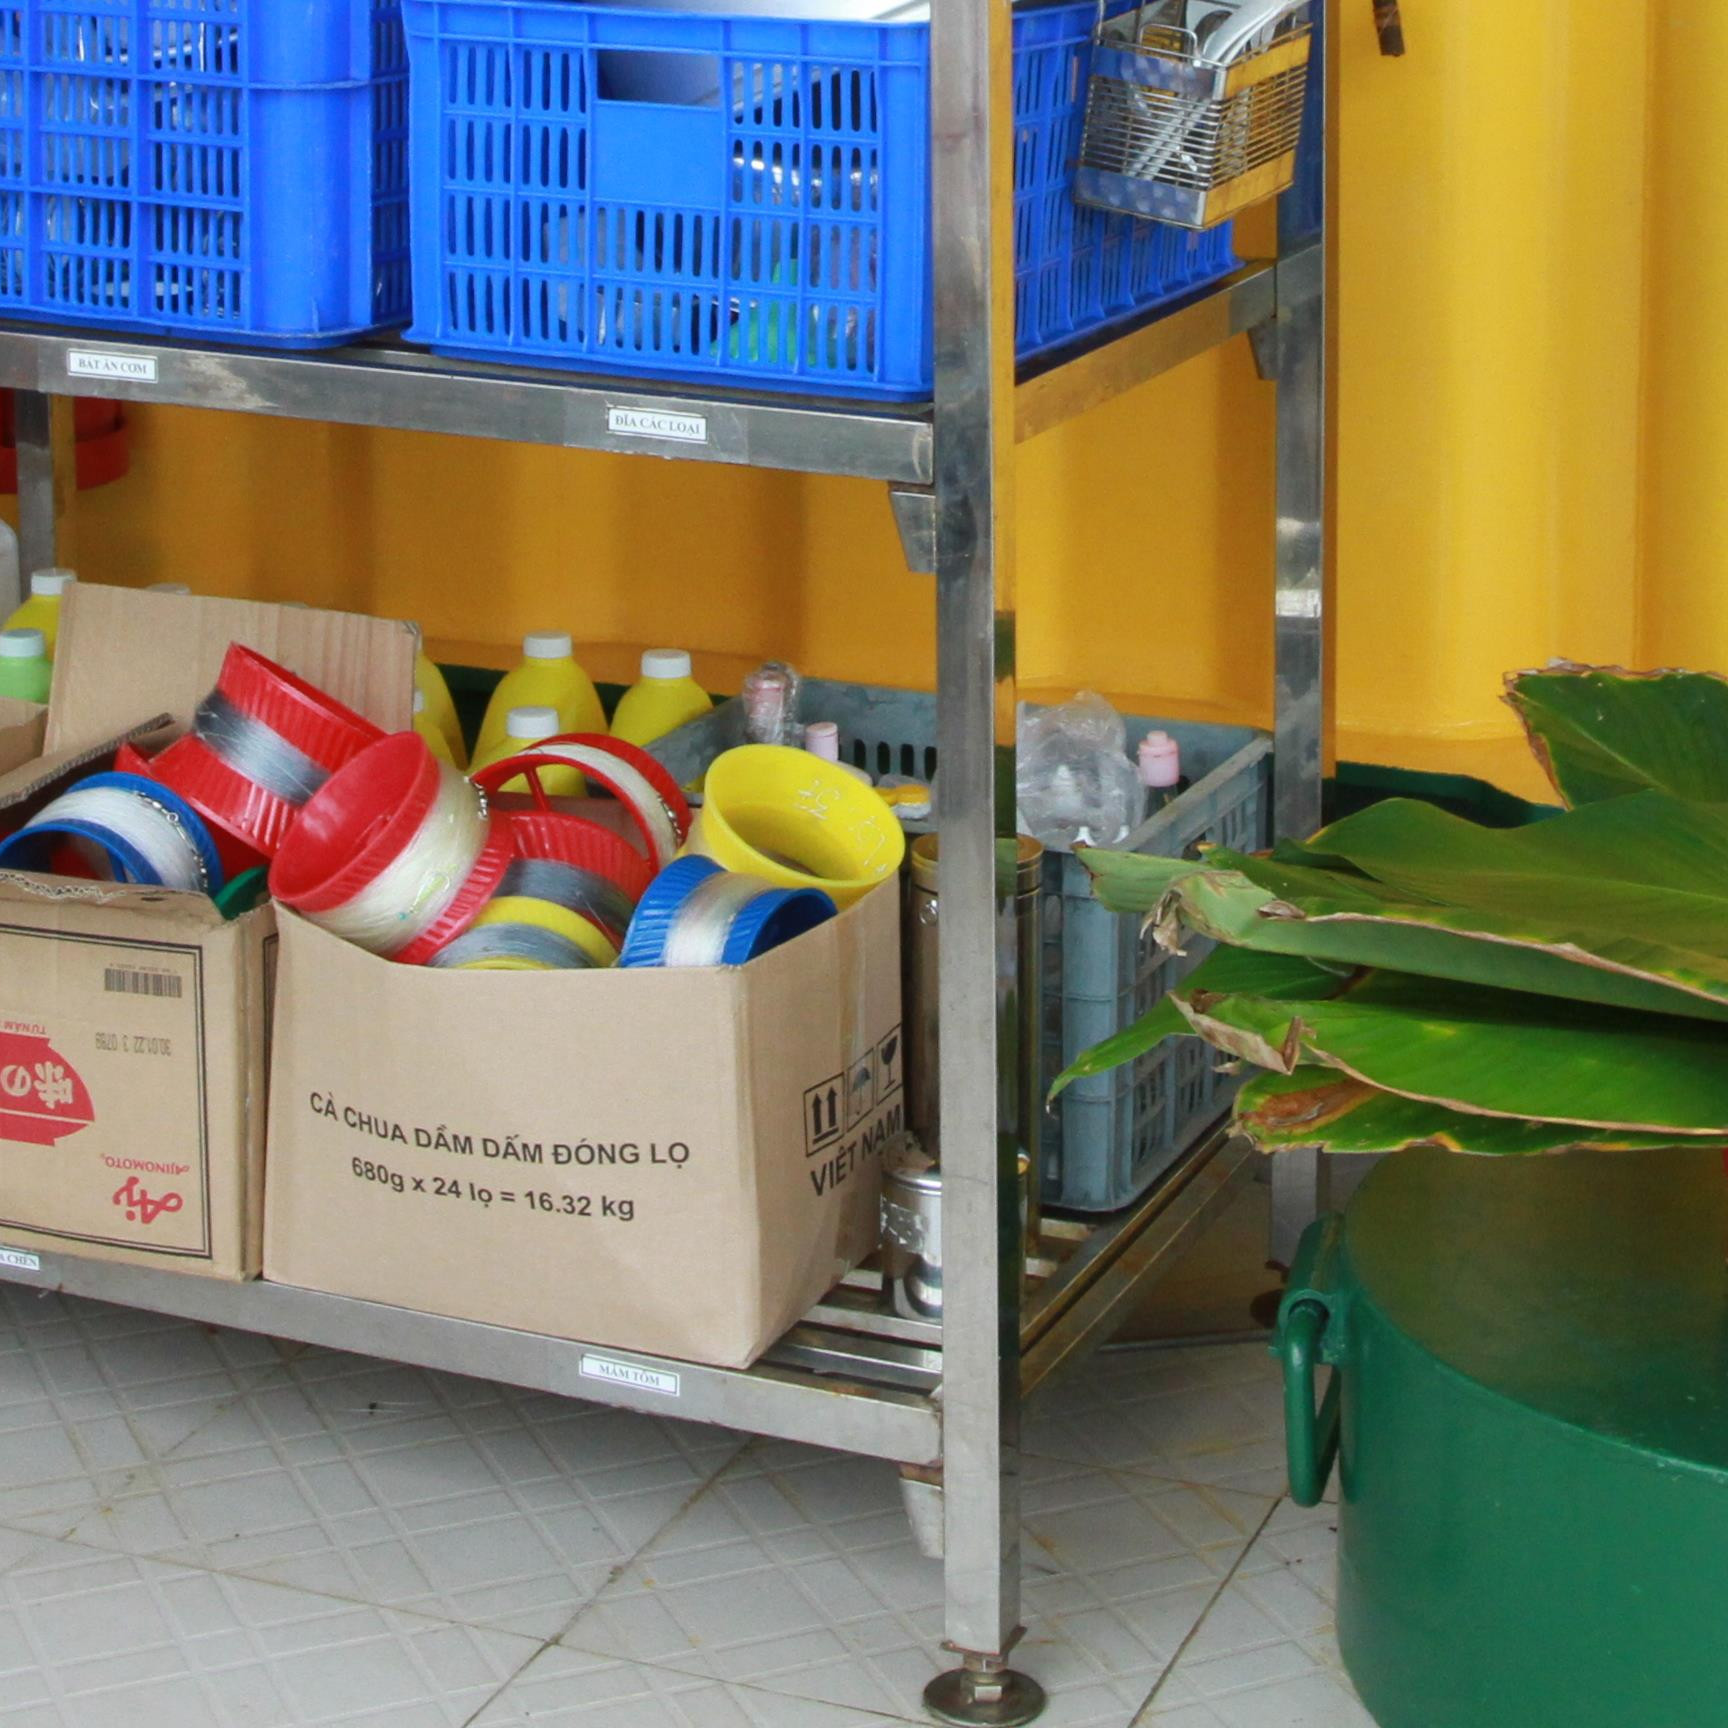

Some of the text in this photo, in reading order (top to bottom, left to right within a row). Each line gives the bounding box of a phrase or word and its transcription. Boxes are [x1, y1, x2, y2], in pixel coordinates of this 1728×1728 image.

[640, 416, 666, 430] CÁC
[310, 1091, 338, 1122] CÀ
[344, 1106, 408, 1145] CHUA
[482, 1133, 544, 1165] DẤM
[552, 1138, 640, 1166] ĐÓNG
[650, 1141, 690, 1170] LỌ
[862, 1104, 901, 1161] NAM
[104, 1155, 190, 1175] AJINOMOTO
[351, 1156, 404, 1193] 680g
[412, 1177, 426, 1193] x
[433, 1176, 462, 1199] 24
[468, 1182, 493, 1208] lọ
[524, 1189, 593, 1217] 16.32
[601, 1195, 635, 1222] kg
